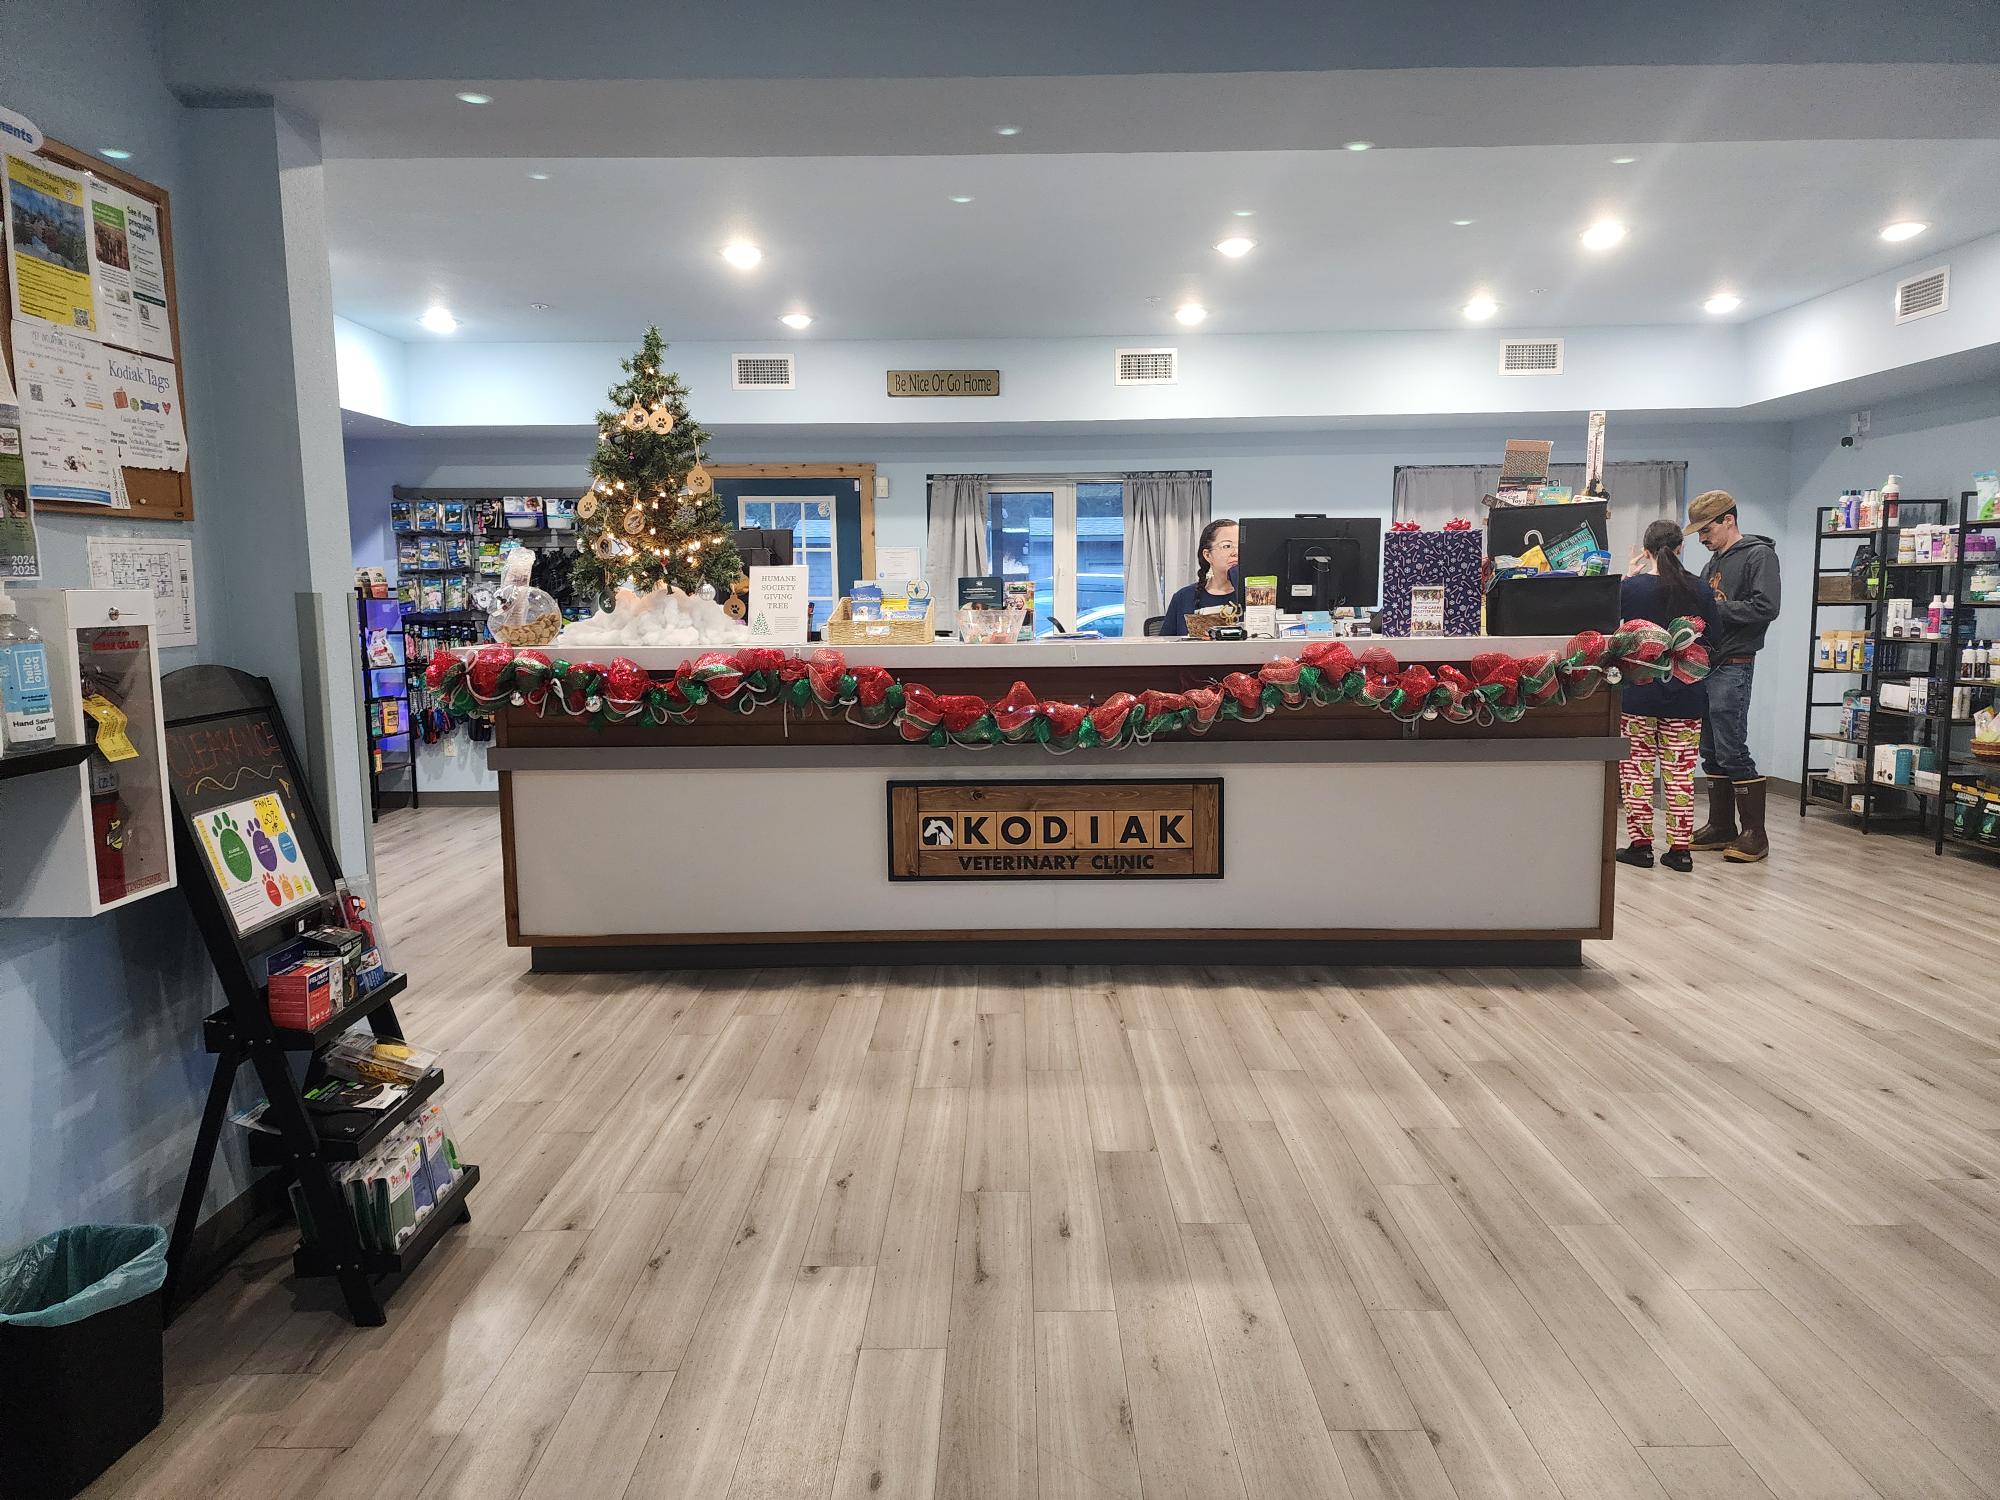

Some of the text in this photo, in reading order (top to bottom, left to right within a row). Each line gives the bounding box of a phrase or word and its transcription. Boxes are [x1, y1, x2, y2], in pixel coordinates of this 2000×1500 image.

[127, 205, 137, 217] See
[142, 213, 152, 223] you
[128, 218, 155, 236] prequalify
[129, 228, 146, 241] today!
[108, 360, 170, 394] Kodiak Tags
[895, 373, 992, 392] Be Nice Or Go Home
[12, 555, 35, 566] 2024
[13, 565, 37, 576] 2025
[116, 640, 140, 650] GLASS
[23, 656, 35, 684] hello
[12, 719, 34, 727] Hand
[963, 814, 1186, 846] KODIAK
[957, 853, 1155, 872] VETERINARY CLINIC
[309, 969, 329, 984] FELIWAY
